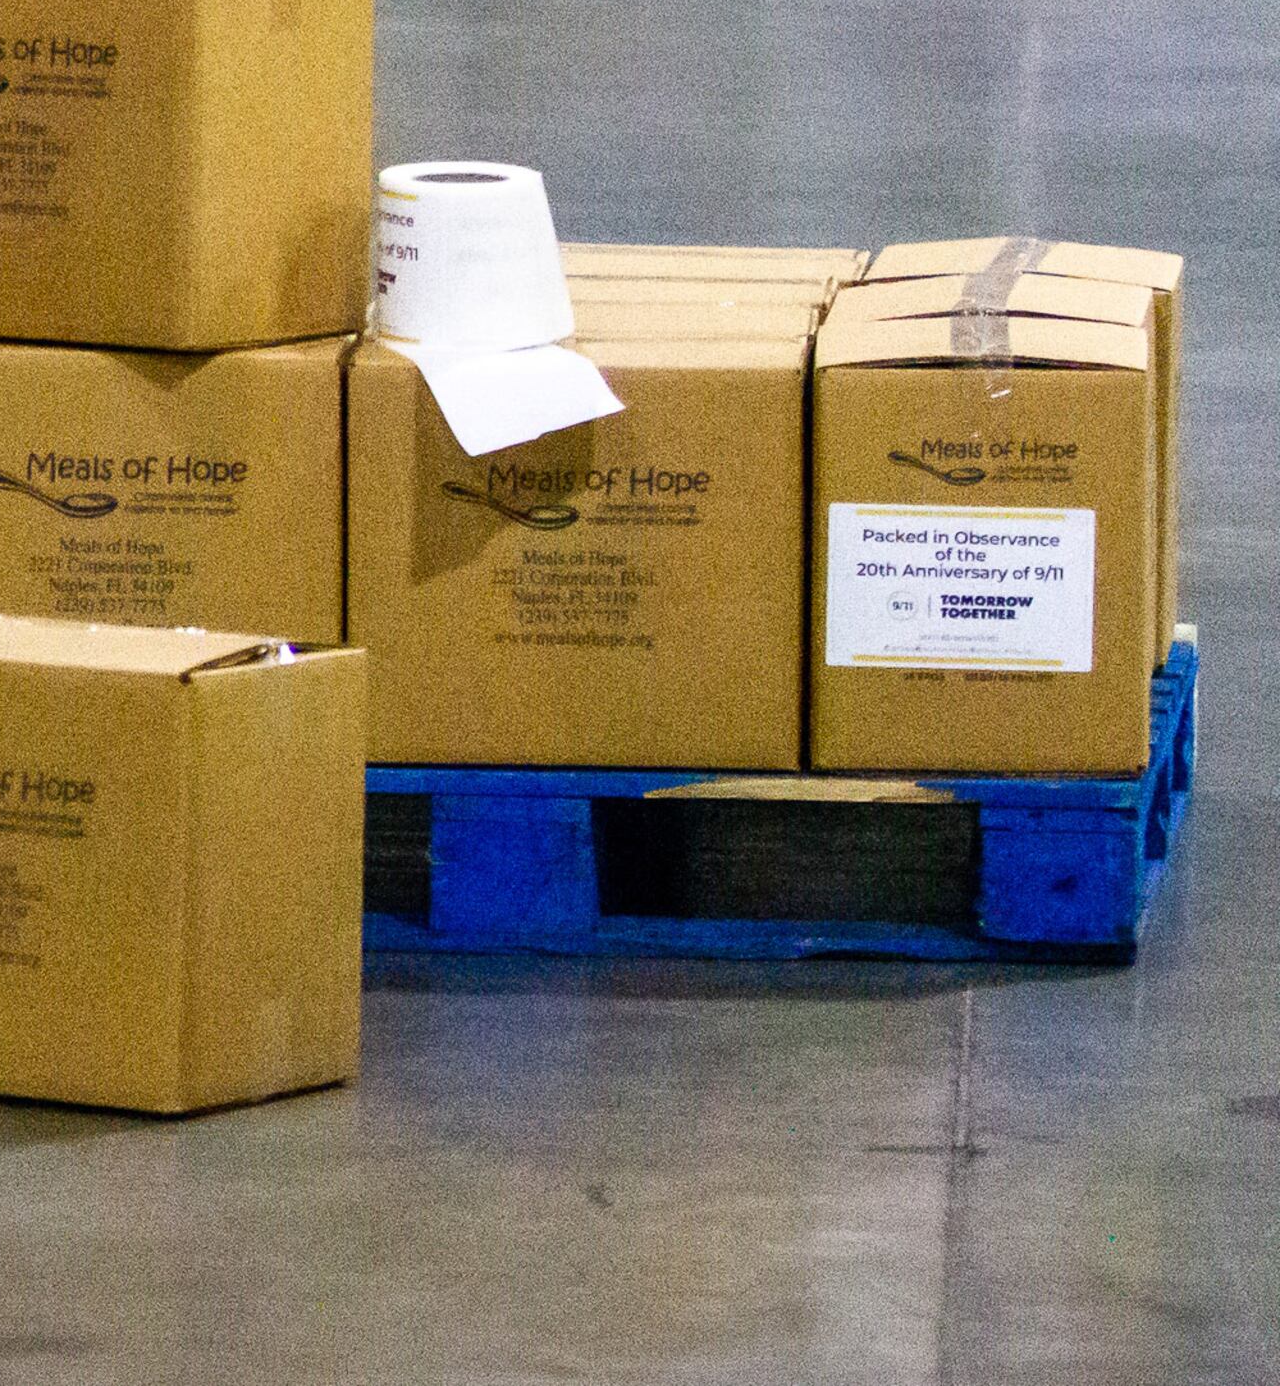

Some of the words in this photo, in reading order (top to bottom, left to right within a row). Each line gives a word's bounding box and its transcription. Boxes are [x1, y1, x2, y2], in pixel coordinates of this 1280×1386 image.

[12, 37, 44, 65] of
[49, 37, 119, 69] Hope
[920, 437, 984, 461] Meals
[988, 438, 1016, 460] of
[1019, 438, 1079, 463] Hope
[26, 451, 115, 484] Meals
[121, 455, 159, 484] of
[167, 455, 248, 487] Hope
[486, 464, 575, 495] Meals
[584, 467, 622, 493] of
[629, 466, 711, 498] Hope
[862, 528, 929, 544] Packed
[932, 529, 950, 545] in
[953, 530, 1061, 548] Observance
[934, 547, 955, 562] of
[957, 548, 987, 563] the
[856, 561, 898, 578] 20th
[901, 563, 1009, 583] Anniversary
[1011, 565, 1031, 581] of
[1033, 564, 1065, 582] 9/11
[891, 600, 914, 611] 9/11
[940, 594, 1034, 608] TOMORROW
[940, 607, 1016, 620] TOGETHER
[19, 771, 96, 808] Hope
